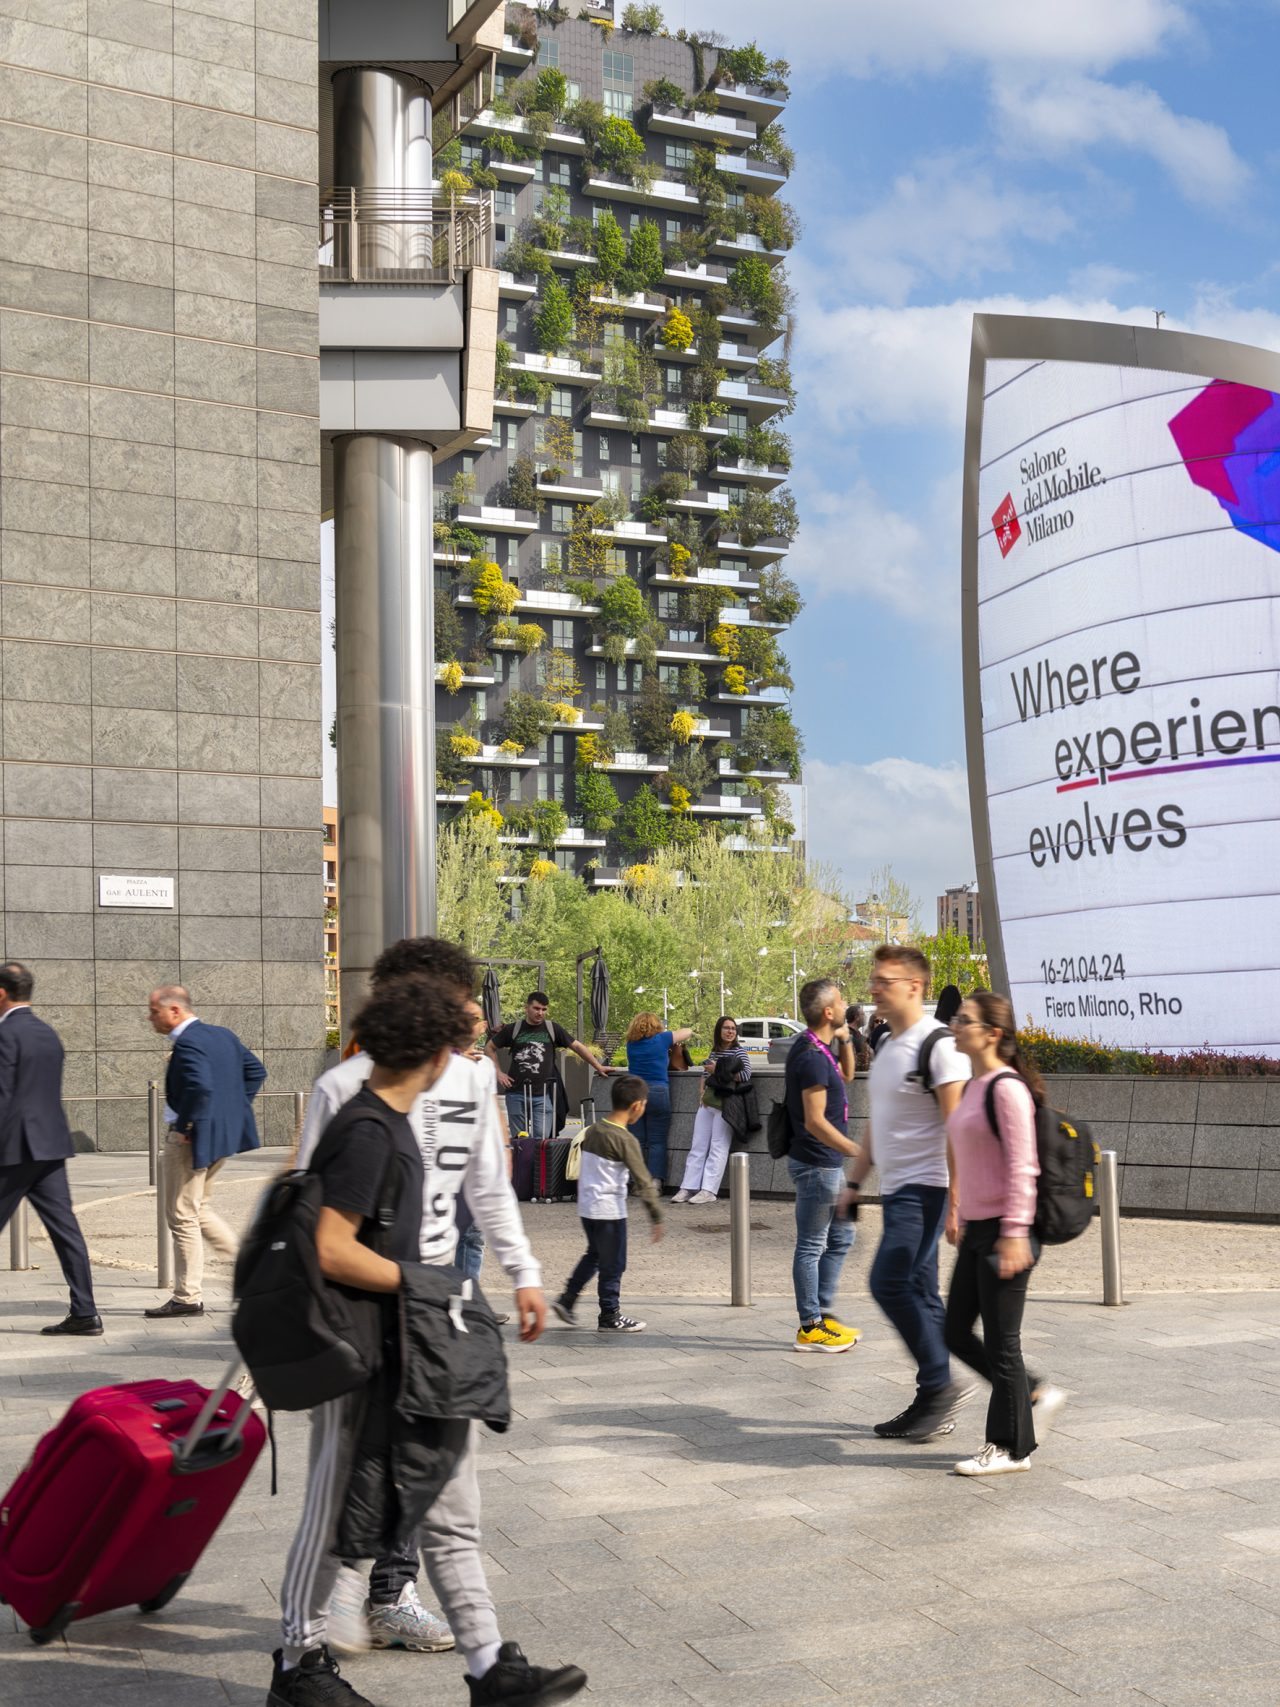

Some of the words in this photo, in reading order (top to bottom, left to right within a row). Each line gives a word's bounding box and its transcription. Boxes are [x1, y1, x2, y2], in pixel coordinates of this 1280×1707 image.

[1020, 447, 1067, 485] Salone
[1026, 509, 1074, 546] Milano
[1010, 651, 1141, 723] Where
[1029, 801, 1188, 868] evolves
[125, 888, 168, 897] AULENTI
[1041, 953, 1126, 984] 16-21.04.24
[1045, 997, 1076, 1018] Fiera
[1078, 994, 1135, 1021] Milano,
[1139, 992, 1182, 1015] Rho
